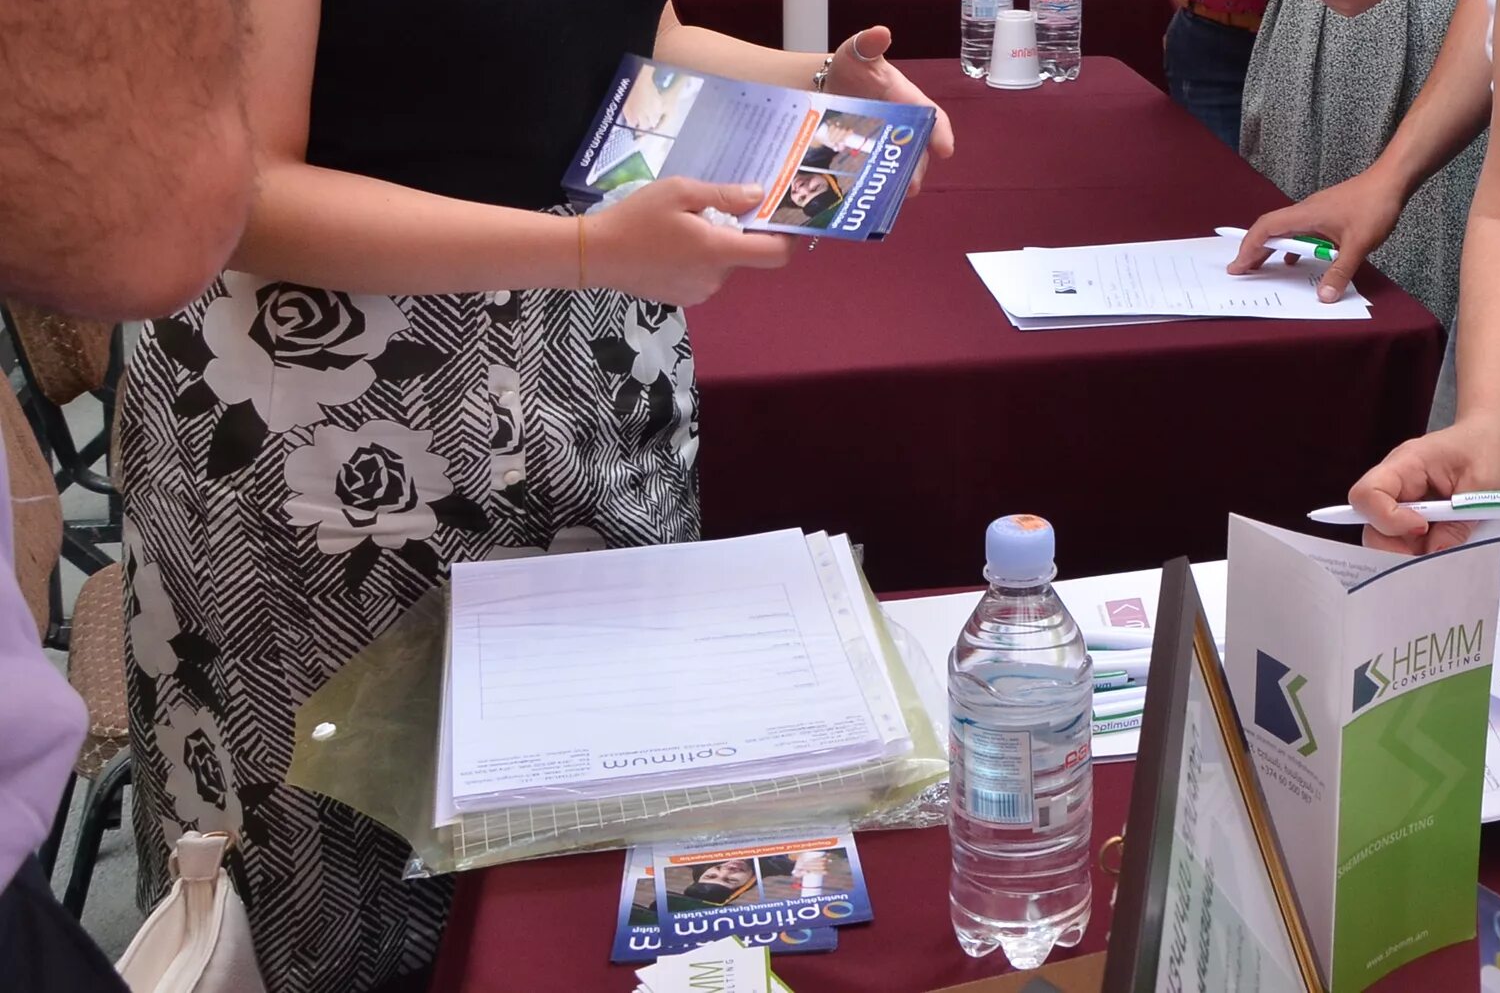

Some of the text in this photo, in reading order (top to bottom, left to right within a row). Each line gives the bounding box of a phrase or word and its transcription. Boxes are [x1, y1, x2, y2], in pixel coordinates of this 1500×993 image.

[843, 123, 914, 232] Optimum
[1391, 652, 1482, 691] CONSULTING
[602, 745, 737, 770] Optimum
[674, 900, 855, 937] Optimum
